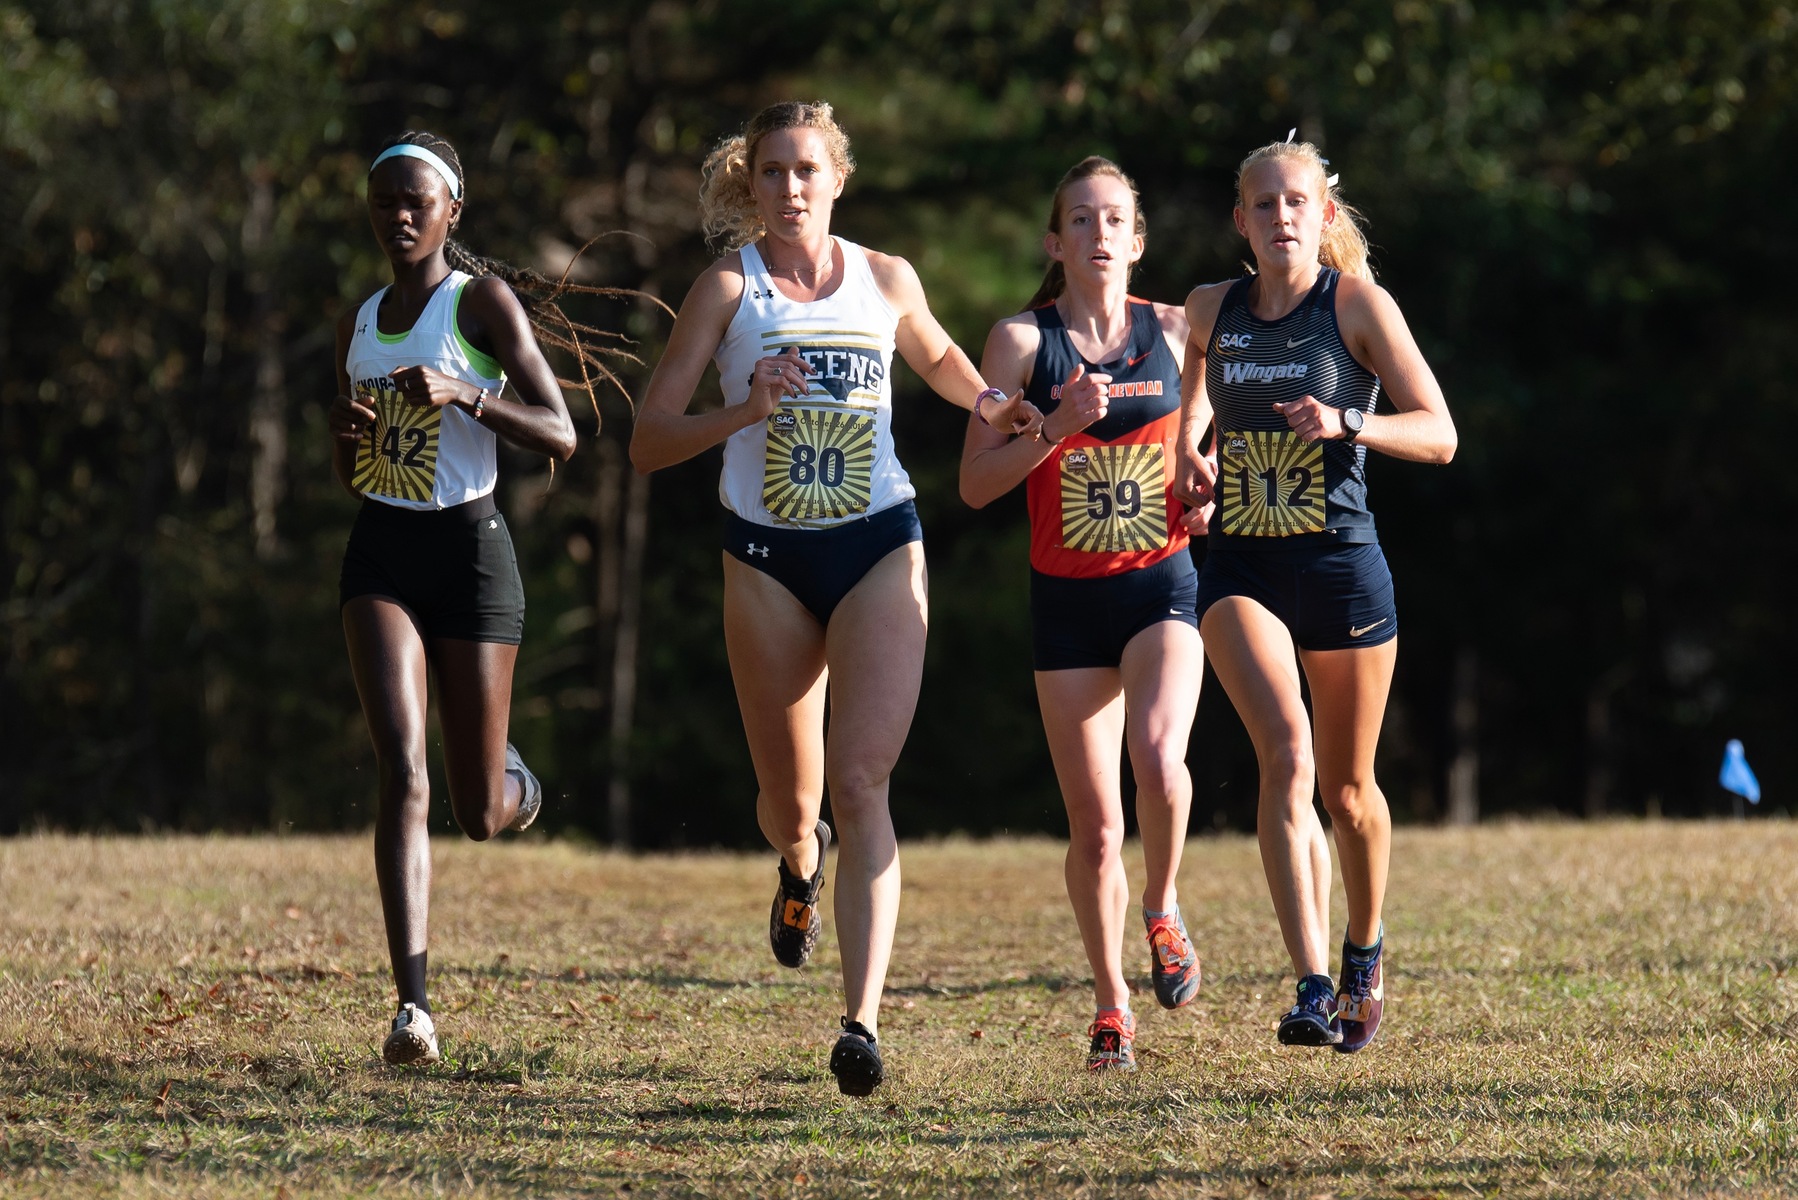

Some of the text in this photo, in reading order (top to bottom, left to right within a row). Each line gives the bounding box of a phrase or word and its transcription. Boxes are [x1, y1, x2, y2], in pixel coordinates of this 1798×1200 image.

[1219, 333, 1252, 348] SAC
[801, 350, 885, 394] EENS
[1223, 362, 1308, 384] Wingate
[776, 415, 795, 425] SAC
[800, 417, 833, 427] Otoer
[365, 421, 428, 468] 142
[1231, 439, 1246, 448] SAC
[1250, 440, 1281, 448] Otoer
[1068, 454, 1087, 464] SAC
[1092, 453, 1124, 462] Otoer
[789, 443, 845, 488] 80
[1234, 466, 1313, 507] 112
[1087, 479, 1141, 520] 59
